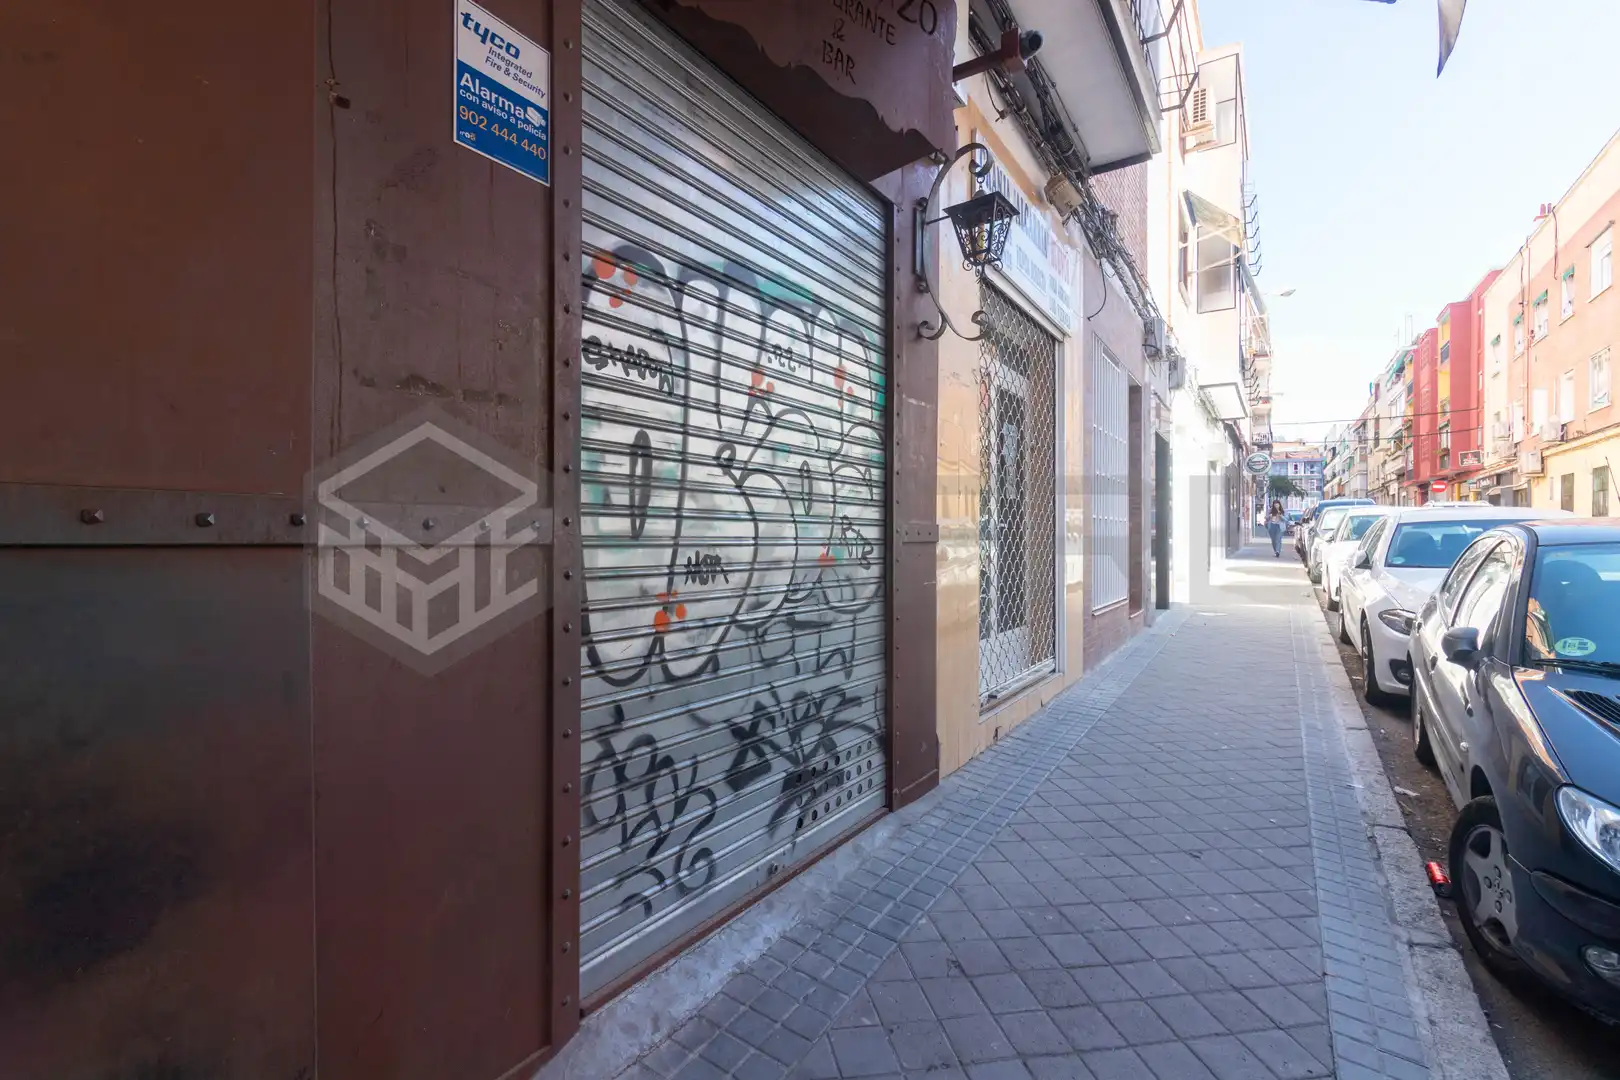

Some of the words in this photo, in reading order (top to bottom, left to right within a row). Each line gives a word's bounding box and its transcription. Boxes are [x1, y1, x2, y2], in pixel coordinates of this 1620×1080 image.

[460, 11, 521, 60] tyco
[830, 17, 846, 42] &
[485, 56, 502, 72] Fire
[503, 66, 511, 78] &
[512, 73, 546, 99] Security
[488, 46, 533, 79] Integrated
[821, 39, 856, 85] BAR
[459, 88, 480, 105] con
[482, 100, 508, 120] aviso
[509, 116, 516, 125] a
[518, 119, 547, 141] policía
[460, 72, 525, 119] Alarma
[459, 105, 488, 131] 902
[491, 123, 518, 145] 444
[521, 139, 546, 160] 440
